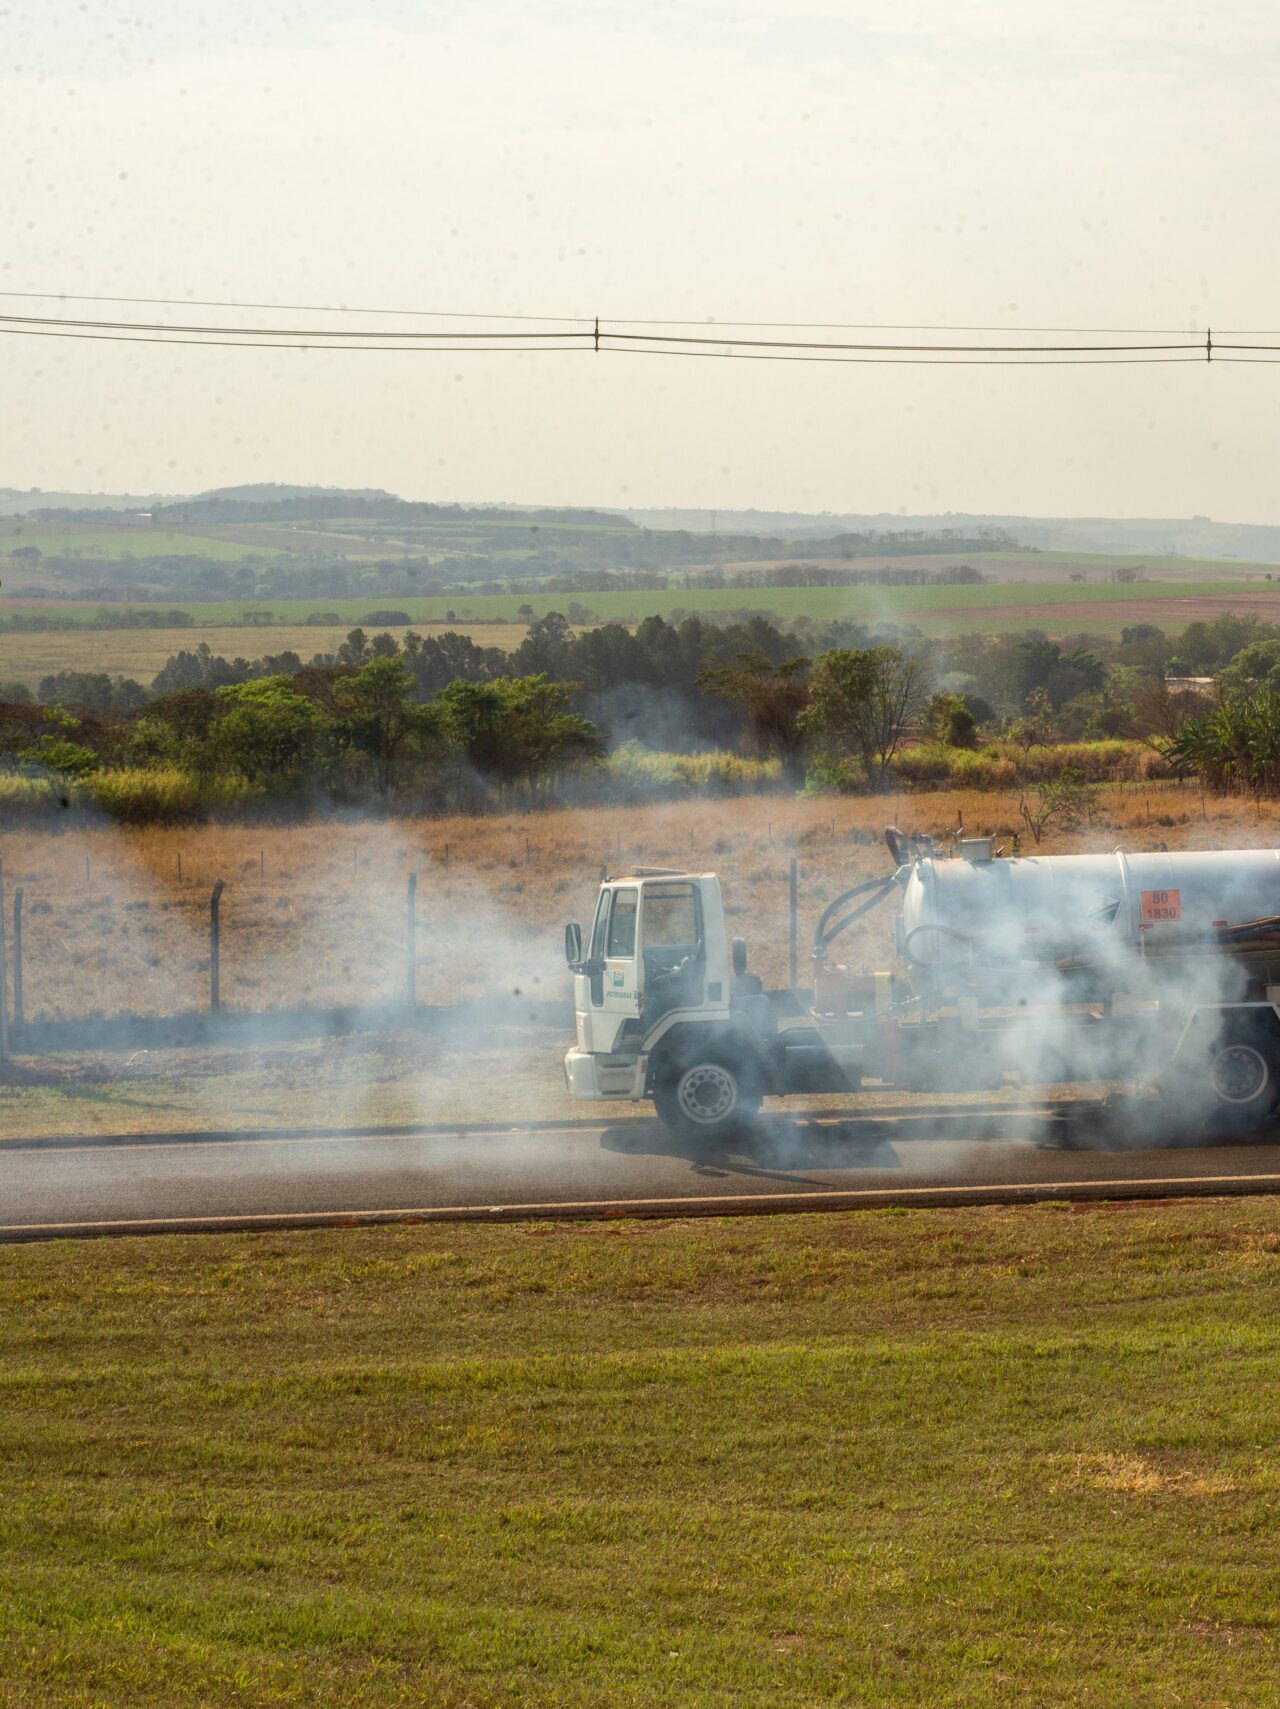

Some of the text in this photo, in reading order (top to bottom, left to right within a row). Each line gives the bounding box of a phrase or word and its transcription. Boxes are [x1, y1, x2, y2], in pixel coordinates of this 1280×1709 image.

[1152, 892, 1168, 904] 80
[1147, 907, 1176, 919] 1830
[606, 991, 632, 999] PETROBRAS
